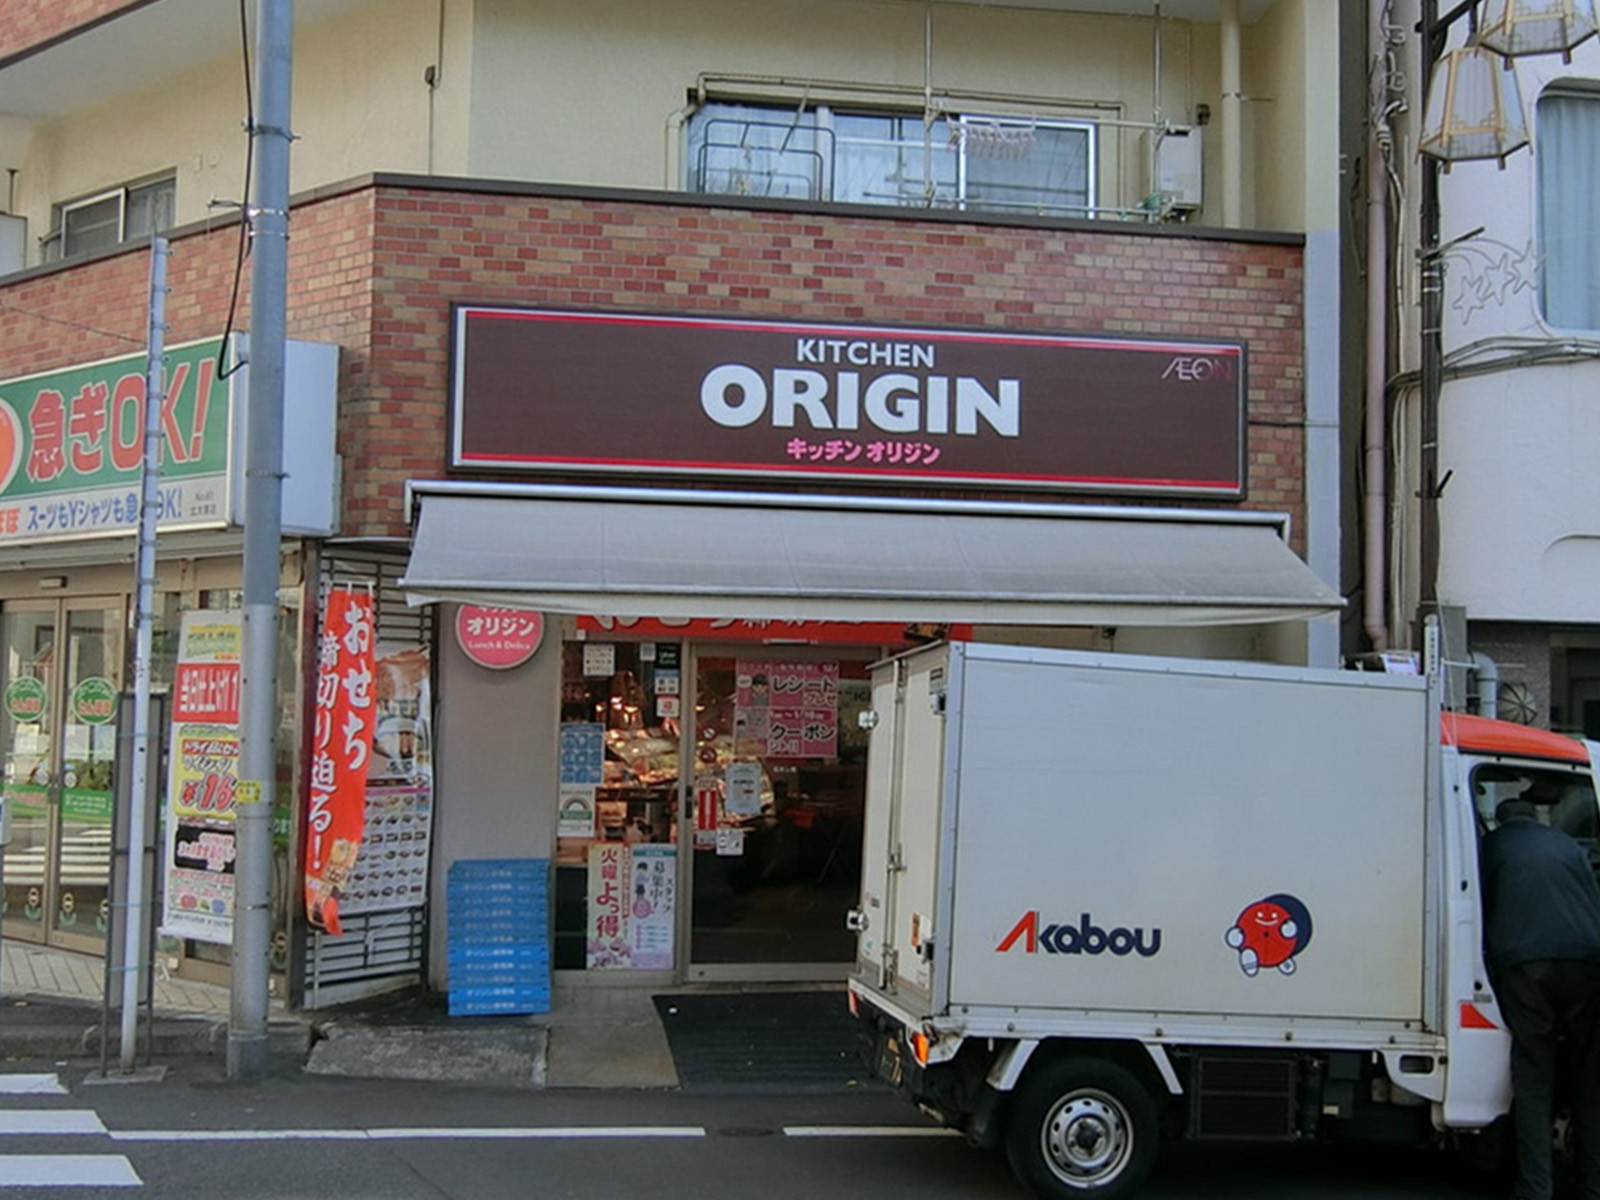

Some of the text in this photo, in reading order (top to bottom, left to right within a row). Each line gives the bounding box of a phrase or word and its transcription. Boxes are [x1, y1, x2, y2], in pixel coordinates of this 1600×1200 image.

[796, 338, 936, 368] KITCHEN
[700, 364, 1021, 437] ORIGIN
[787, 437, 941, 465] キッチン オリジン
[466, 616, 535, 637] オリジン
[342, 602, 374, 770] おせち
[772, 675, 835, 693] レシート
[770, 722, 836, 741] クーポン
[994, 910, 1162, 957] Akabou
